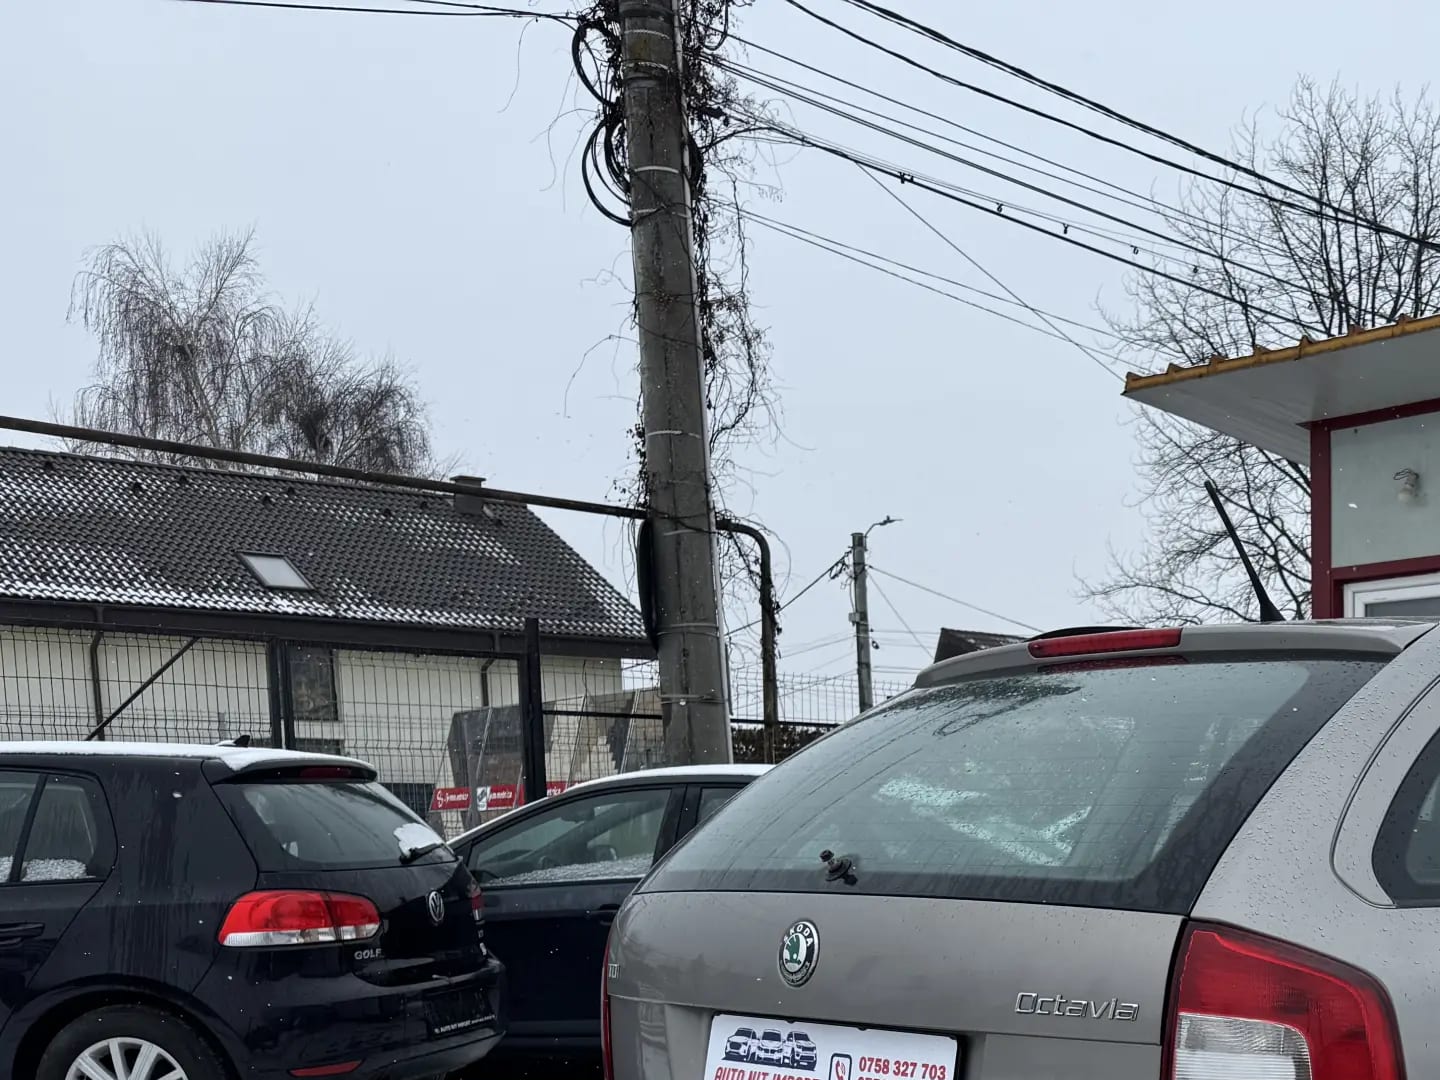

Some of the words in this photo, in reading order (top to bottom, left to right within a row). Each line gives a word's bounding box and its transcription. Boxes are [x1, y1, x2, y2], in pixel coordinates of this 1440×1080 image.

[354, 948, 382, 960] GOLF
[1014, 991, 1141, 1022] Octavia
[859, 1057, 889, 1075] 0758
[893, 1060, 918, 1077] 327
[921, 1062, 946, 1080] 703
